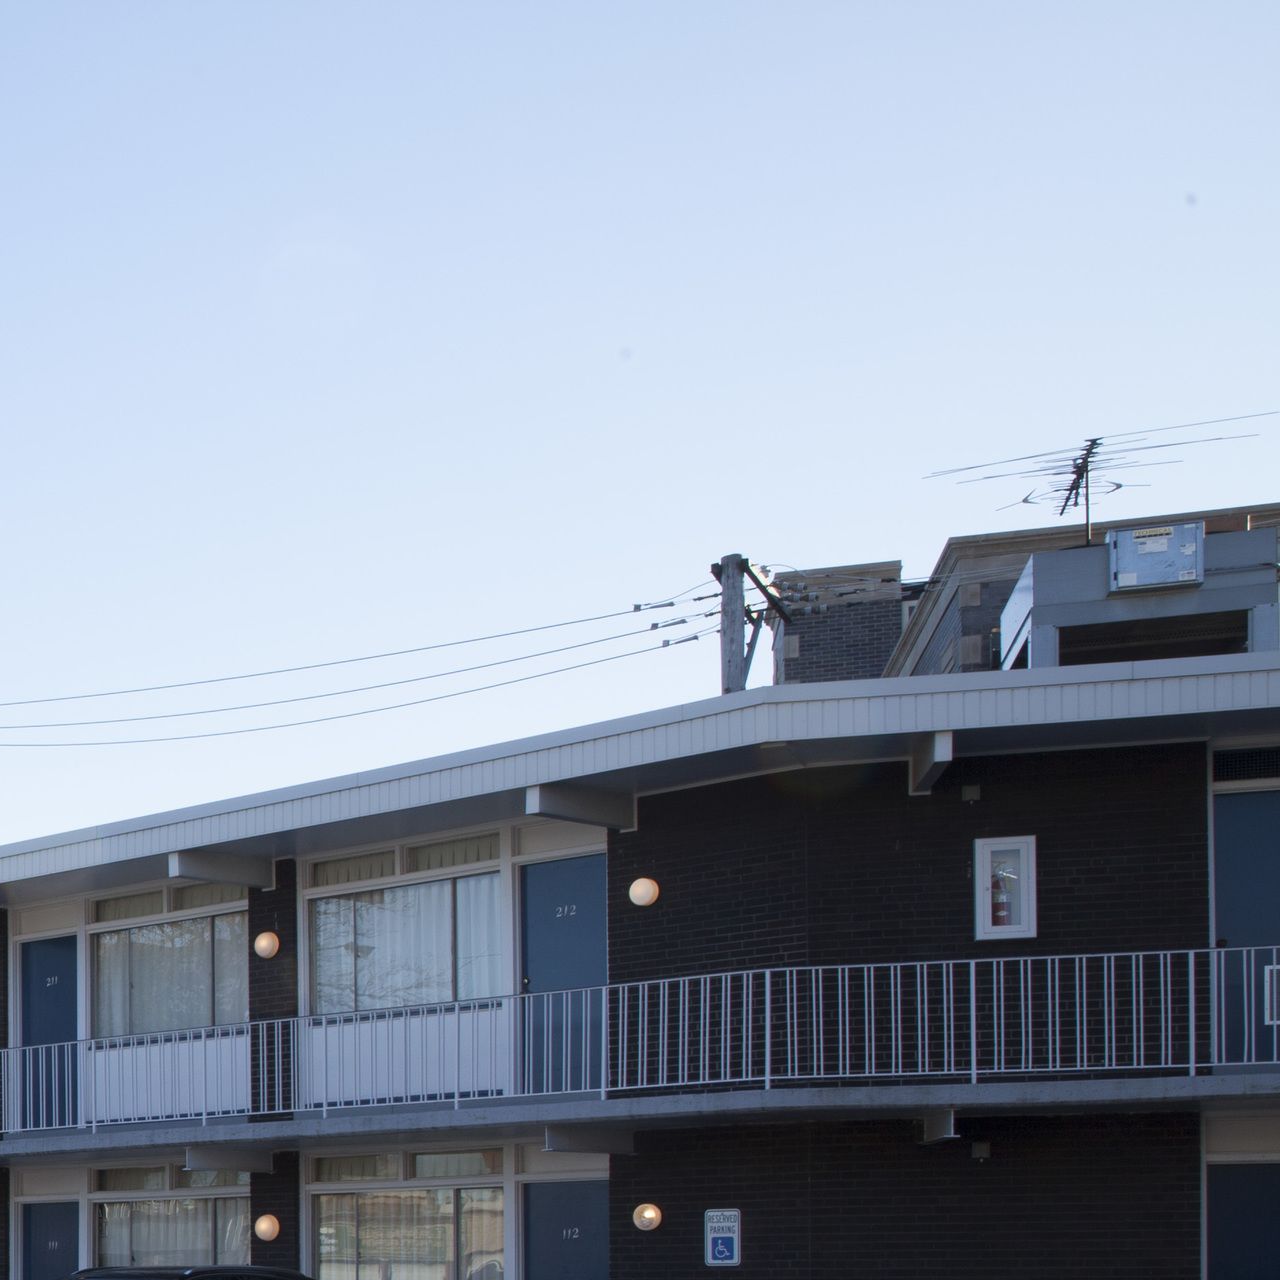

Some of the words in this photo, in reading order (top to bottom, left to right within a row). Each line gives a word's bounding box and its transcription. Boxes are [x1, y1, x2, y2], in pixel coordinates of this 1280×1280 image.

[555, 904, 577, 918] 212
[707, 1214, 738, 1224] RESERVED
[562, 1227, 579, 1240] 112
[709, 1225, 736, 1235] PARKING
